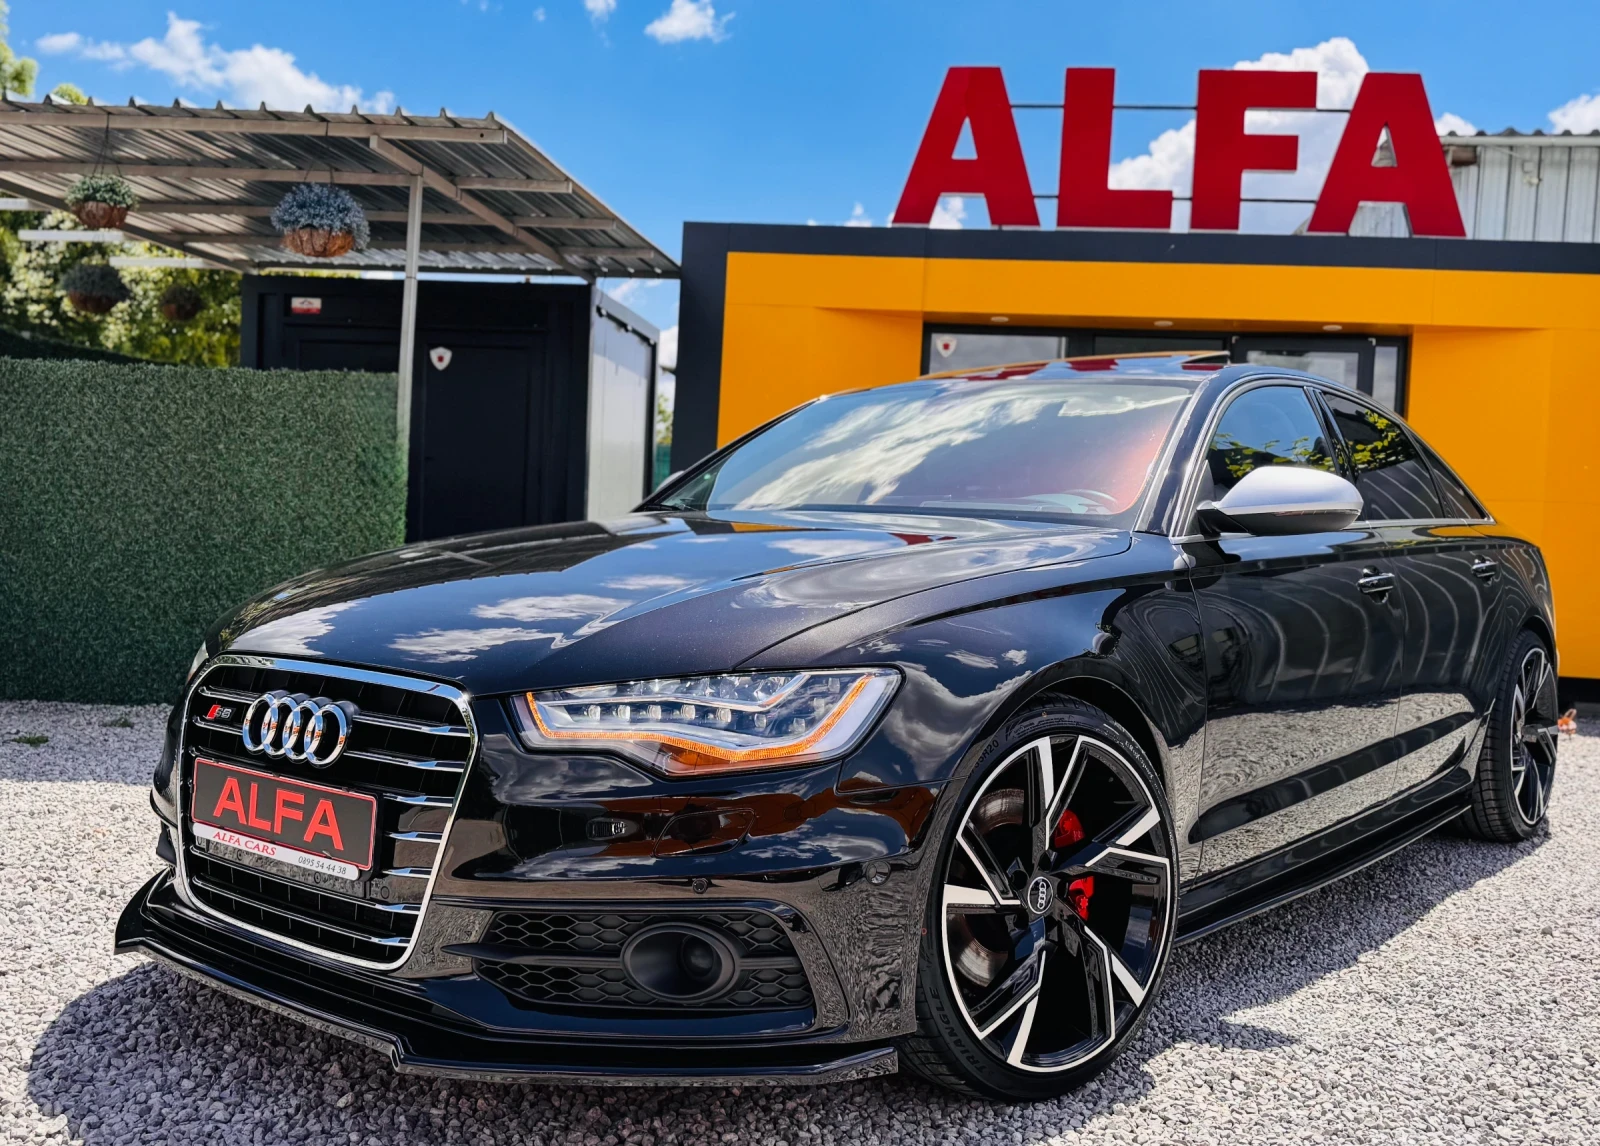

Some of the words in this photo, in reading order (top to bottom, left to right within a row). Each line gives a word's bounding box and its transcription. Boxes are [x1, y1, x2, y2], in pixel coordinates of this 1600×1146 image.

[892, 66, 1466, 238] ALFA
[213, 776, 345, 851] ALFA
[213, 831, 241, 847] ALFA
[244, 840, 277, 856] CARS
[298, 855, 315, 867] 0895
[315, 860, 325, 870] 54
[326, 863, 336, 873] 44
[336, 865, 347, 875] 38
[929, 986, 987, 1073] TRIANGLE
